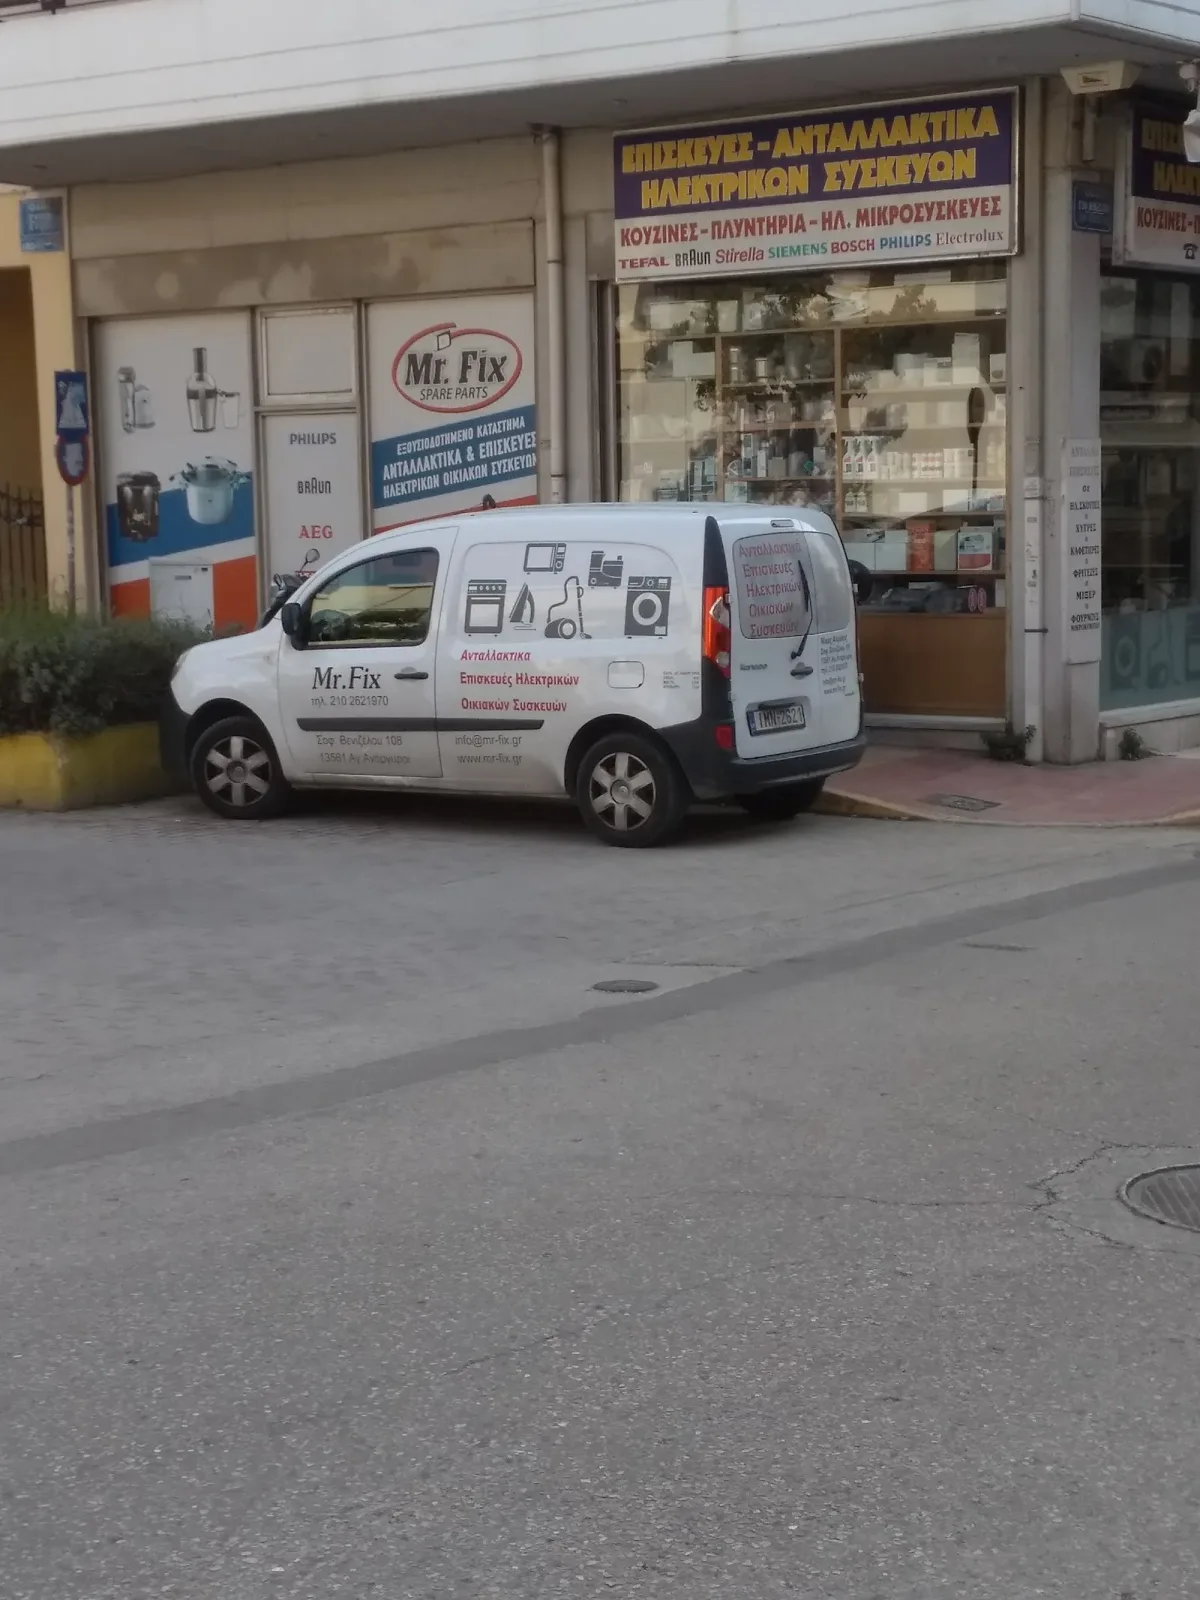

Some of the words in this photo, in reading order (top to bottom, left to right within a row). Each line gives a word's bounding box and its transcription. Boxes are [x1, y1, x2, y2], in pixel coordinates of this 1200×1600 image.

[622, 131, 753, 173] ΕΠΙΣΚΕΥΕΣ
[771, 106, 999, 159] ΑΝΤΑΛΛΑΚΤΙΚΑ
[641, 164, 809, 209] ΗΛΕΚΤΡΙΚΩΝ
[823, 147, 976, 192] ΣΥΣΚΕΥΩΝ
[621, 222, 698, 247] ΚΟΥΖΙΝΕΣ
[711, 213, 806, 240] ΠΛΥΝΤΗΡΙΑ
[821, 210, 851, 231] ΗΛ.
[856, 196, 1001, 228] ΜΙΚΡΟΣΥΣΚΕΥΕΣ
[618, 257, 669, 269] TEFAL
[715, 247, 764, 264] Stirella
[768, 242, 828, 259] SIEMENS
[831, 239, 875, 254] BOSCH
[880, 234, 932, 249] PHILIPS
[936, 229, 1004, 246] Electrolux
[405, 352, 449, 385] Mr.
[458, 348, 507, 383] Fix
[420, 387, 453, 400] SPARE
[455, 386, 488, 399] PARTS
[290, 432, 337, 445] PHILIPS
[397, 427, 473, 455] ΕΞΟΥΣΙΟΔΟΤΗΜΕΝΟ
[477, 416, 525, 438] ΚΑΤΑΣΤΗΜΑ
[383, 448, 462, 481] ΑΝΤΑΛΛΑΚΤΙΚΑ
[479, 431, 536, 459] ΕΠΙΣΚΕΥΕΣ
[383, 474, 439, 499] ΗΛΕΚΤΡΙΚΩΝ
[443, 464, 488, 486] ΟΙΚΙΑΚΩΝ
[298, 525, 333, 539] AEG
[1076, 590, 1096, 600] ΜΙΞΕΡ
[460, 649, 531, 661] Ανταλλακτικα
[460, 672, 513, 688] Επισκευές
[515, 672, 580, 688] Ηλεκτρικών
[461, 697, 510, 711] Οικιακών
[513, 698, 567, 712] Συσκευών
[455, 734, 522, 748] info@mr-fix.gr
[457, 753, 522, 766] www.mr-fix.gr
